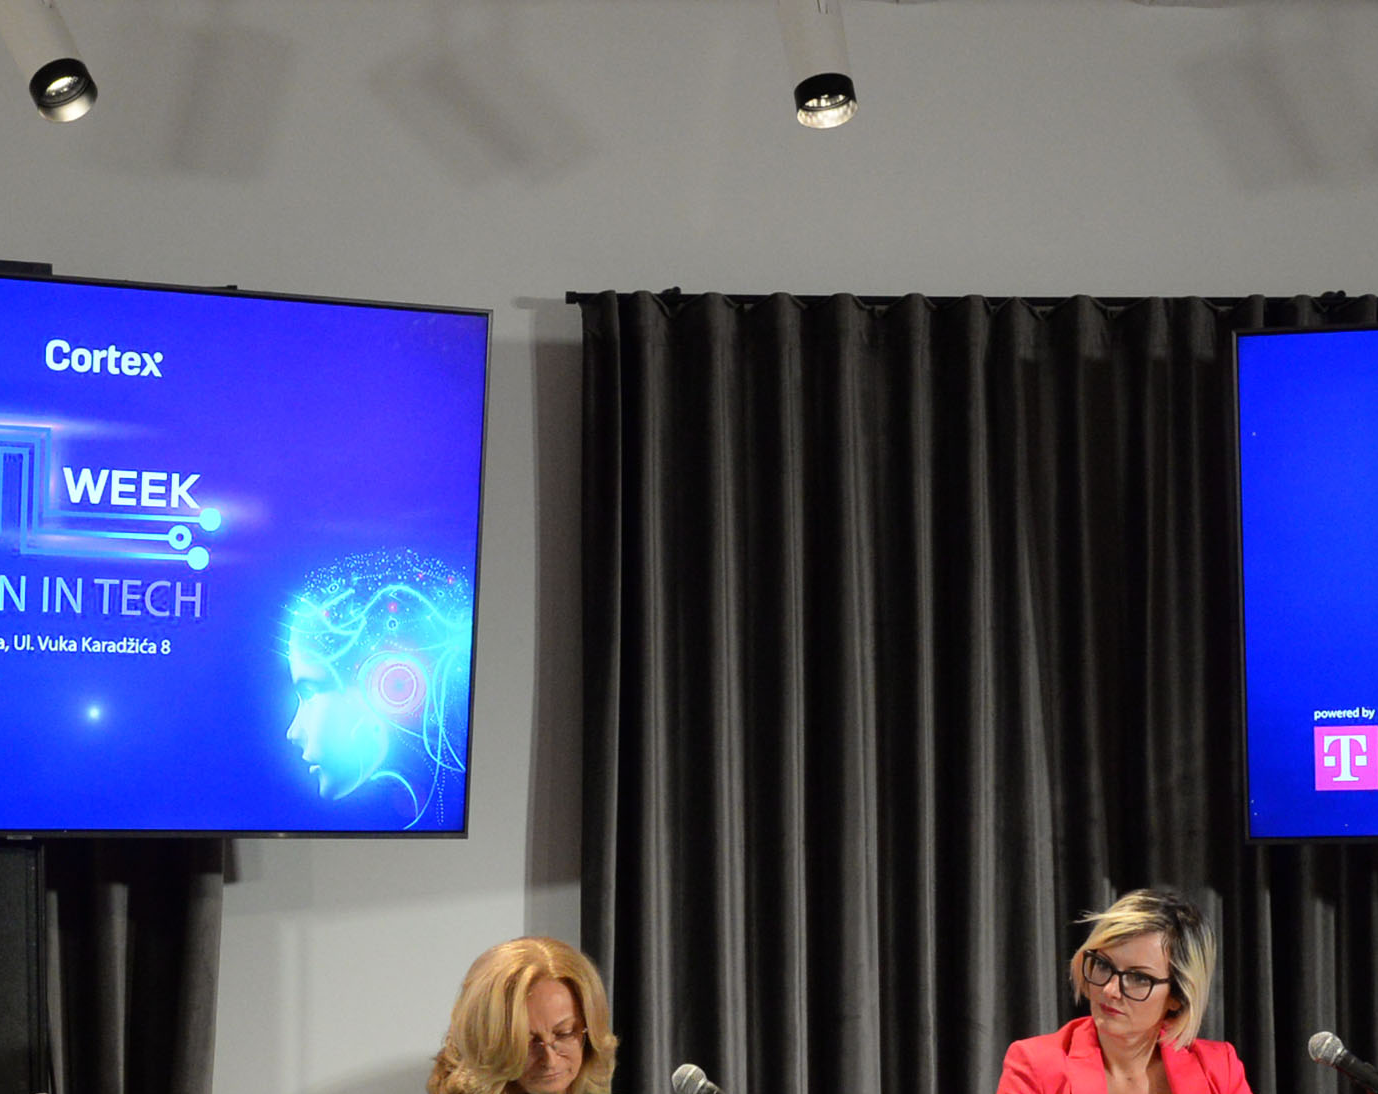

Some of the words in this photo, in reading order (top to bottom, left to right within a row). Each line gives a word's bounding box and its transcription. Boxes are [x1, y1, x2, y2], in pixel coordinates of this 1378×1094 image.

[45, 339, 164, 378] Cortex
[63, 466, 201, 509] WEEK
[42, 576, 82, 614] IN
[94, 578, 203, 618] TECH
[13, 634, 35, 651] Ul.
[37, 635, 78, 652] Vuka
[81, 636, 158, 655] Karadžića
[160, 639, 172, 655] 8
[1313, 706, 1360, 722] powered
[1361, 706, 1376, 720] by
